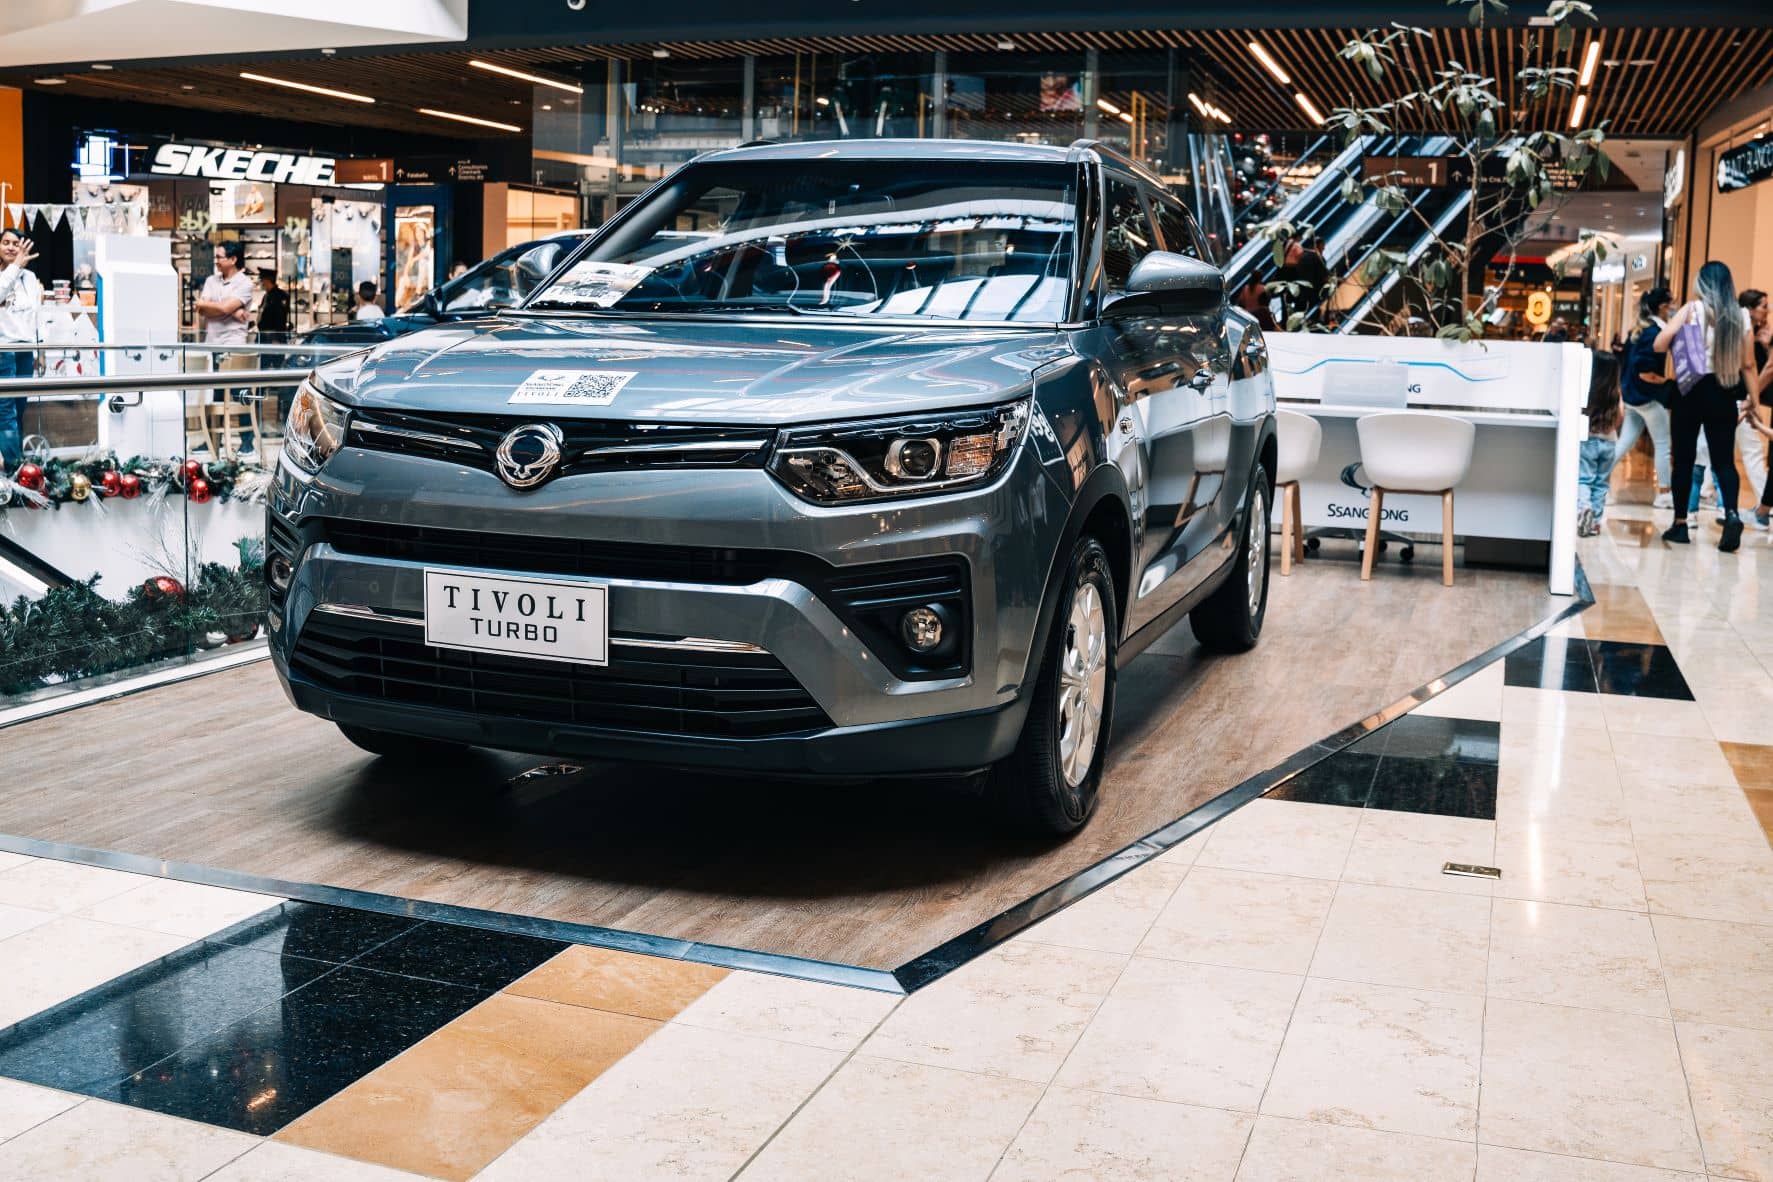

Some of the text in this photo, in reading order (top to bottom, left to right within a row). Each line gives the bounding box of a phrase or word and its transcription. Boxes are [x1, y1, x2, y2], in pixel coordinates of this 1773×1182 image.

[150, 143, 384, 190] SKECHE
[379, 161, 387, 181] 1
[1428, 161, 1438, 185] 1
[1327, 503, 1409, 521] SSANGONG
[443, 585, 586, 622] TIVOLI
[469, 617, 558, 643] TURBO
